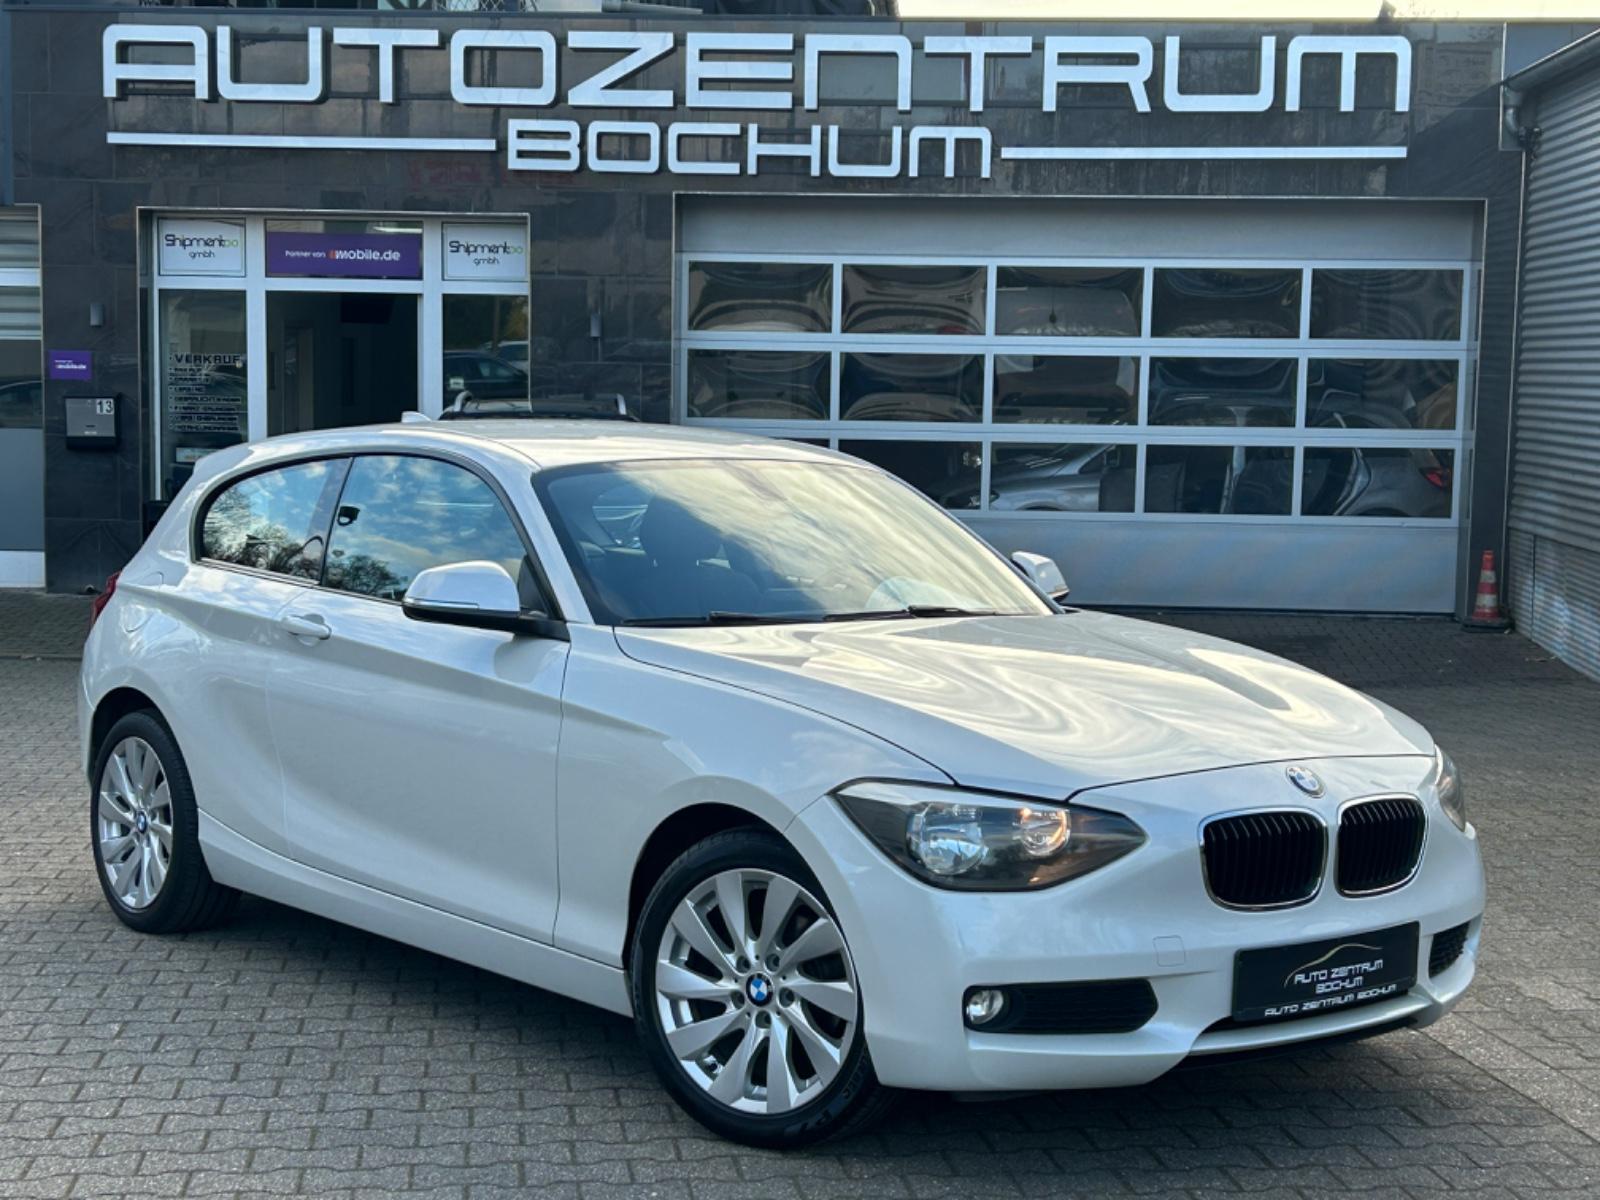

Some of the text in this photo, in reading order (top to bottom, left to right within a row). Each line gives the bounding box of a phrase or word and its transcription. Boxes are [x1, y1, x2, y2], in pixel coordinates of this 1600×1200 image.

[102, 24, 1412, 113] AUTOZENTRUM
[507, 119, 992, 179] BOCHUM
[285, 250, 311, 258] Partner
[335, 249, 401, 261] mobile.de
[174, 354, 240, 364] VERKAUF
[97, 400, 114, 414] 13
[1294, 959, 1383, 985] AUTO ZENTRUM
[1315, 975, 1363, 994] BOCHUM
[1264, 983, 1397, 1016] AUTO ZENTRUM BOCHUM
